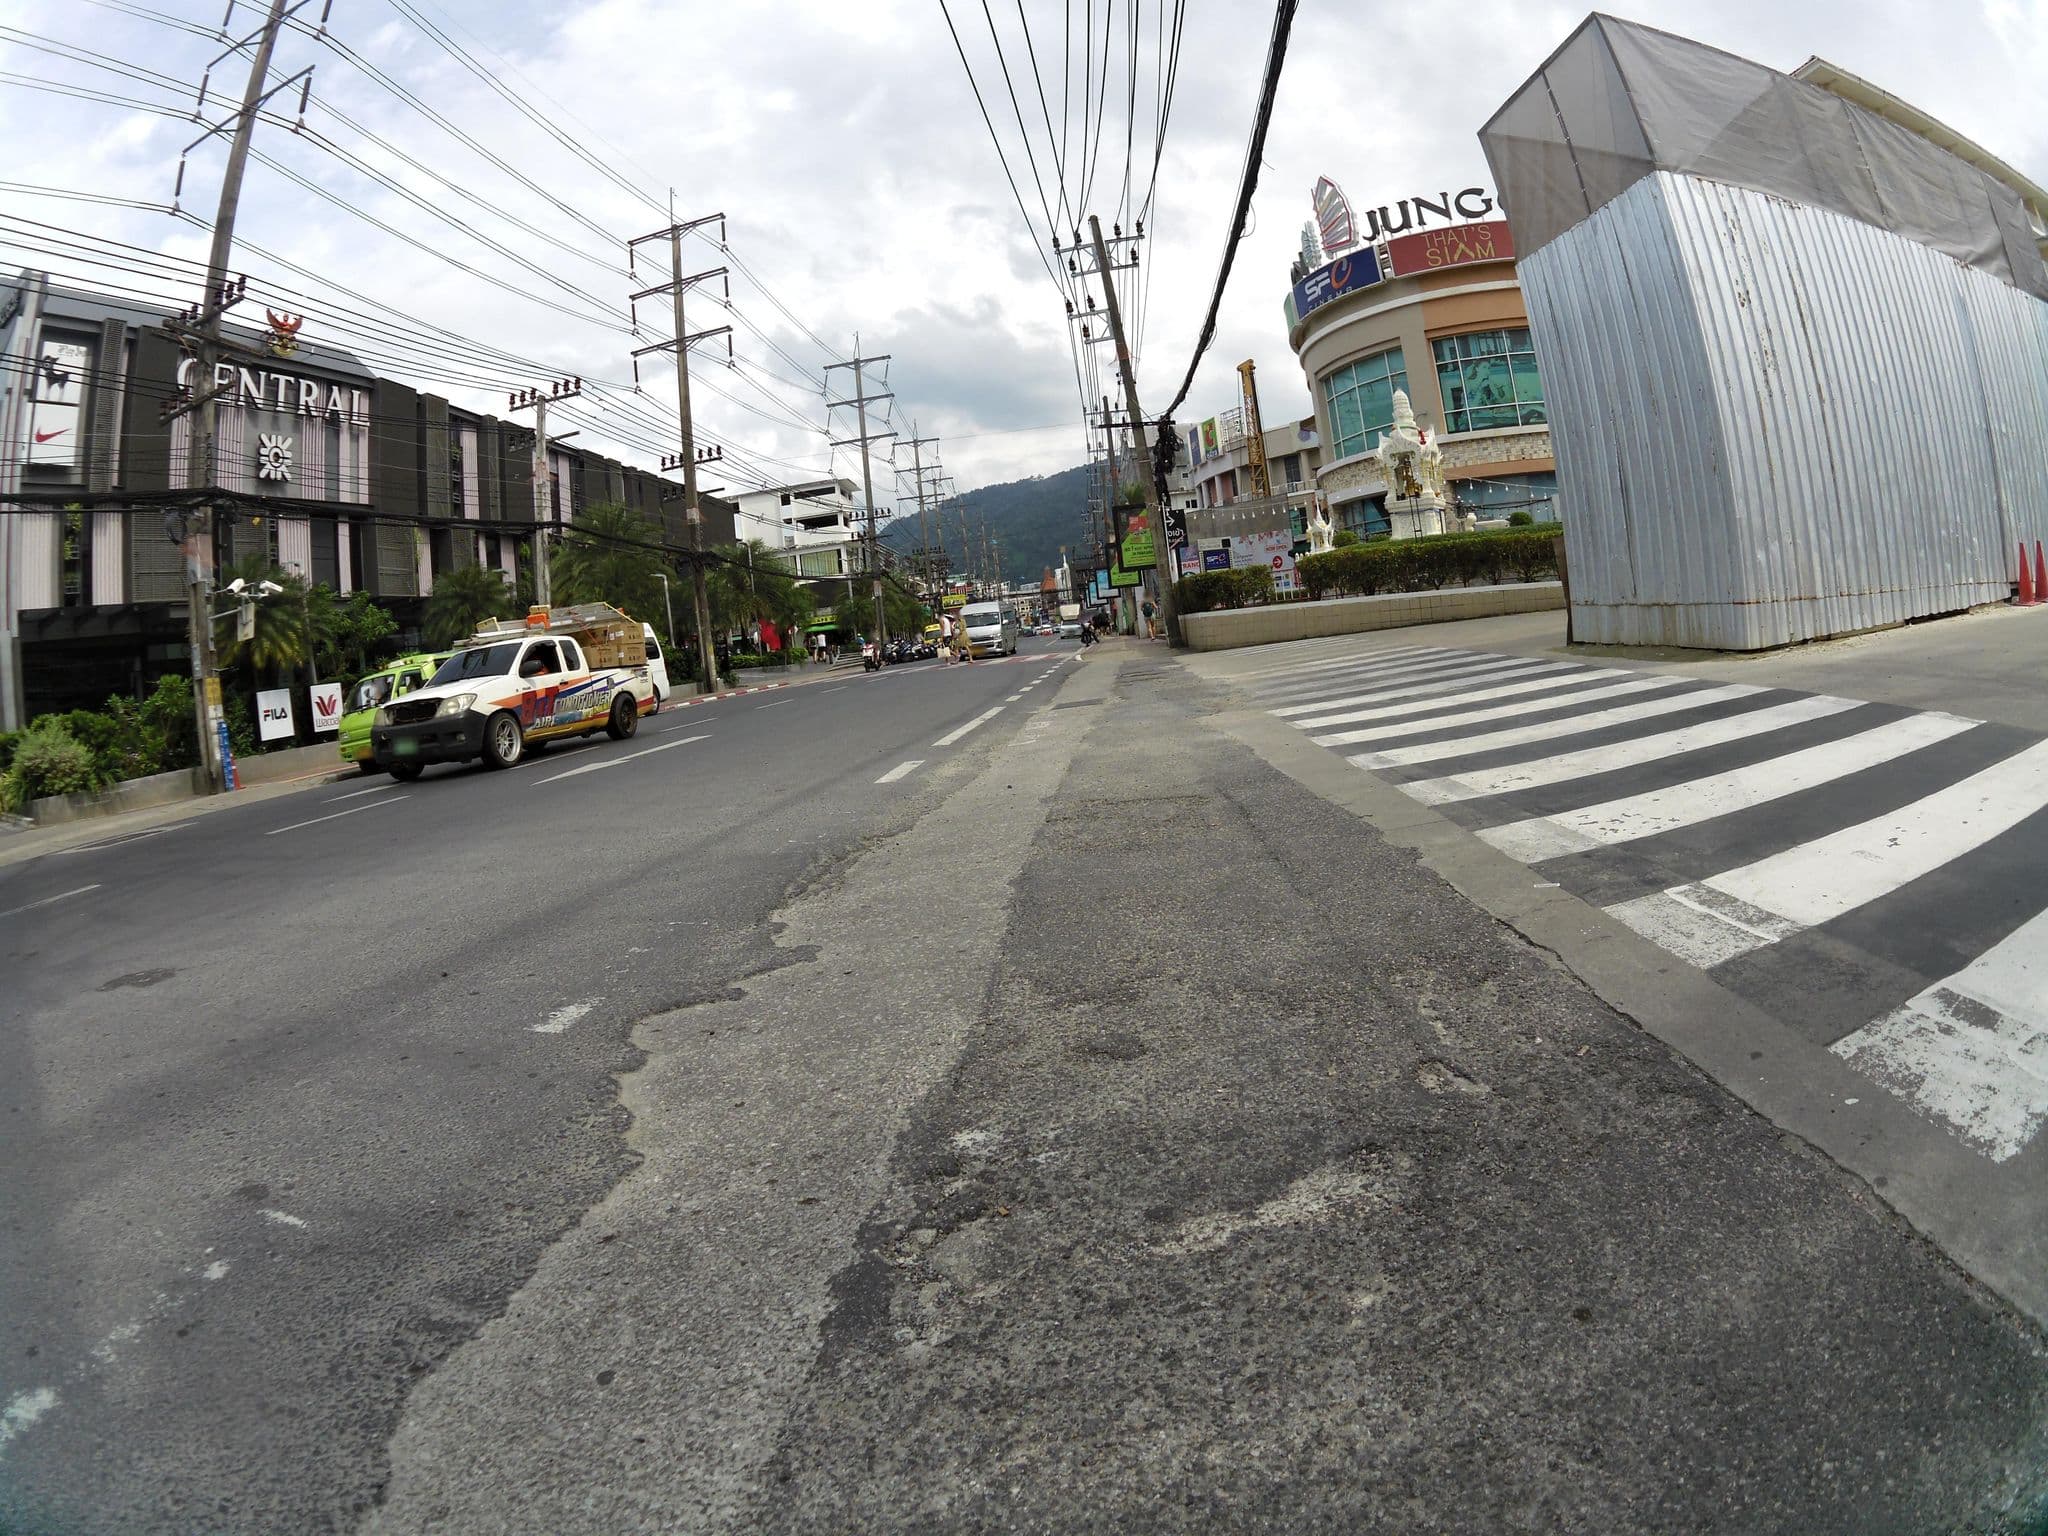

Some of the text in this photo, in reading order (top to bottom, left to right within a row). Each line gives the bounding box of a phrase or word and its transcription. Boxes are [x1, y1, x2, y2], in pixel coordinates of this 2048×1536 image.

[1362, 187, 1504, 241] JUNG
[1421, 225, 1491, 249] THAT'S
[1426, 240, 1495, 267] SIAM
[177, 358, 370, 427] CENTRAL
[263, 707, 288, 721] FILA
[316, 716, 340, 727] Wacoa
